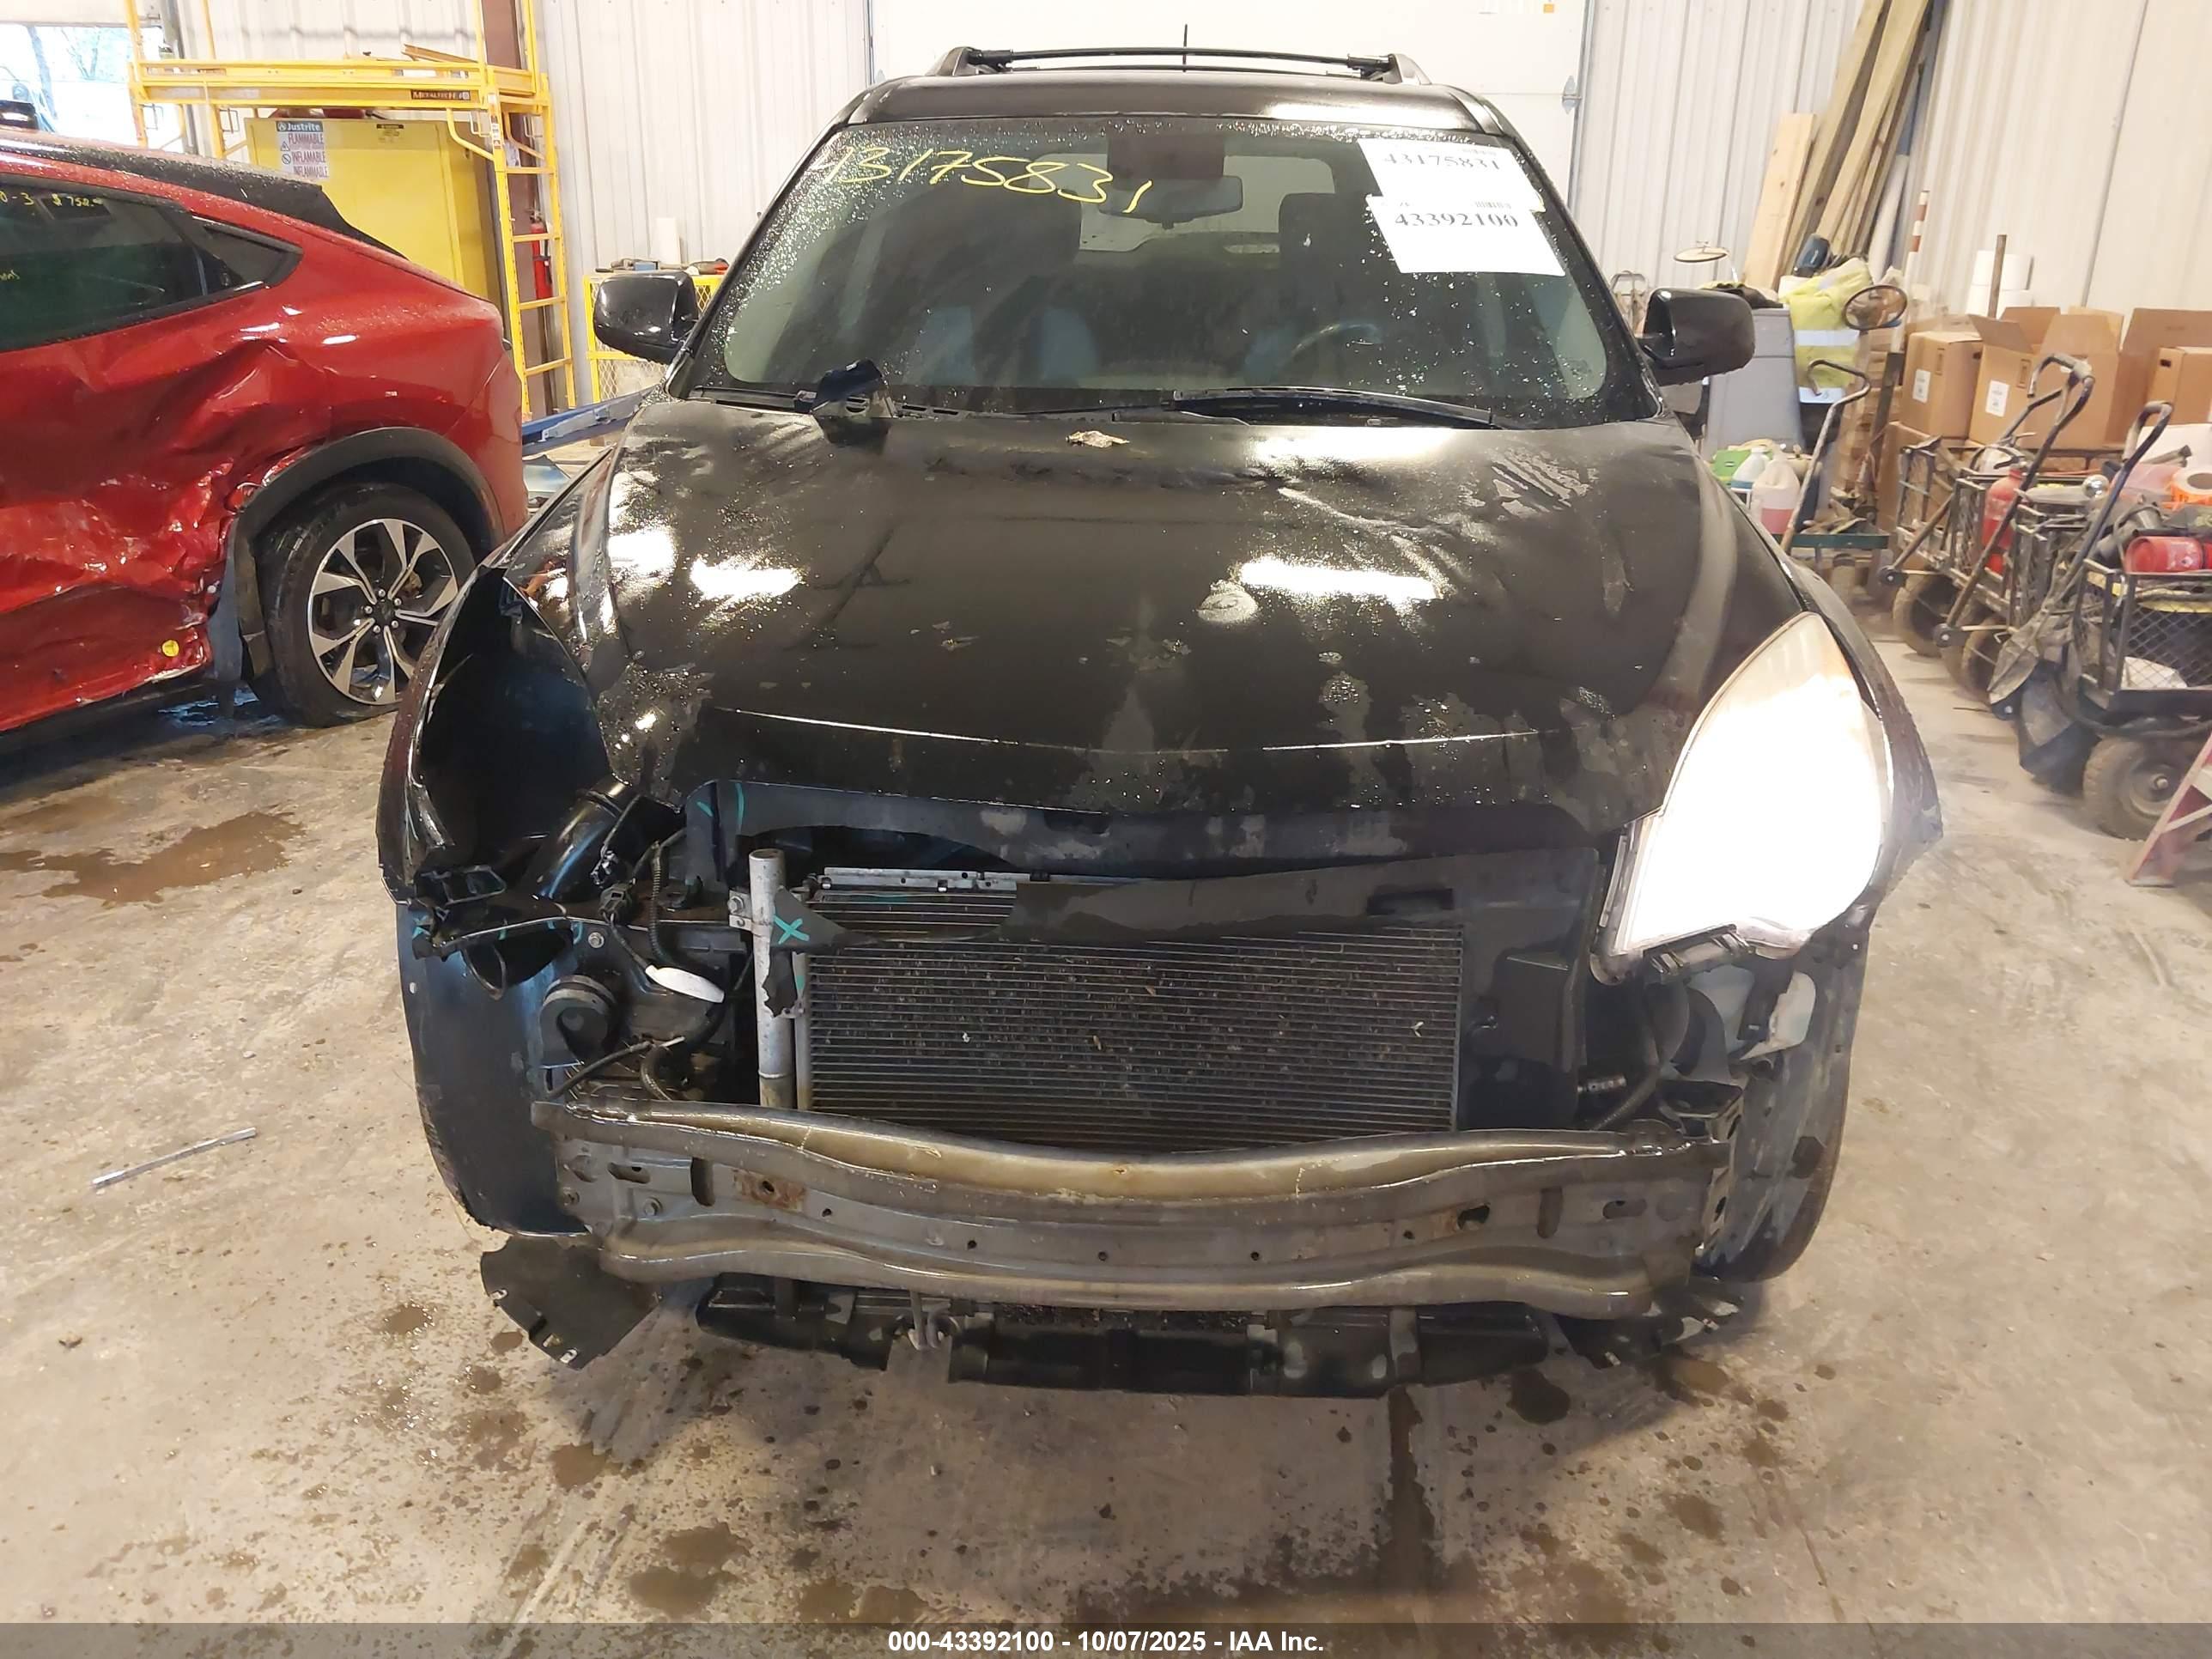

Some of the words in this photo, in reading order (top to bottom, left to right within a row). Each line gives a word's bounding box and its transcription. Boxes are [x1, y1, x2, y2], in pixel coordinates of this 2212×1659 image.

[289, 133, 325, 144] FLAMMABLE
[1384, 154, 1500, 170] 43175831
[1395, 213, 1518, 227] 43392100
